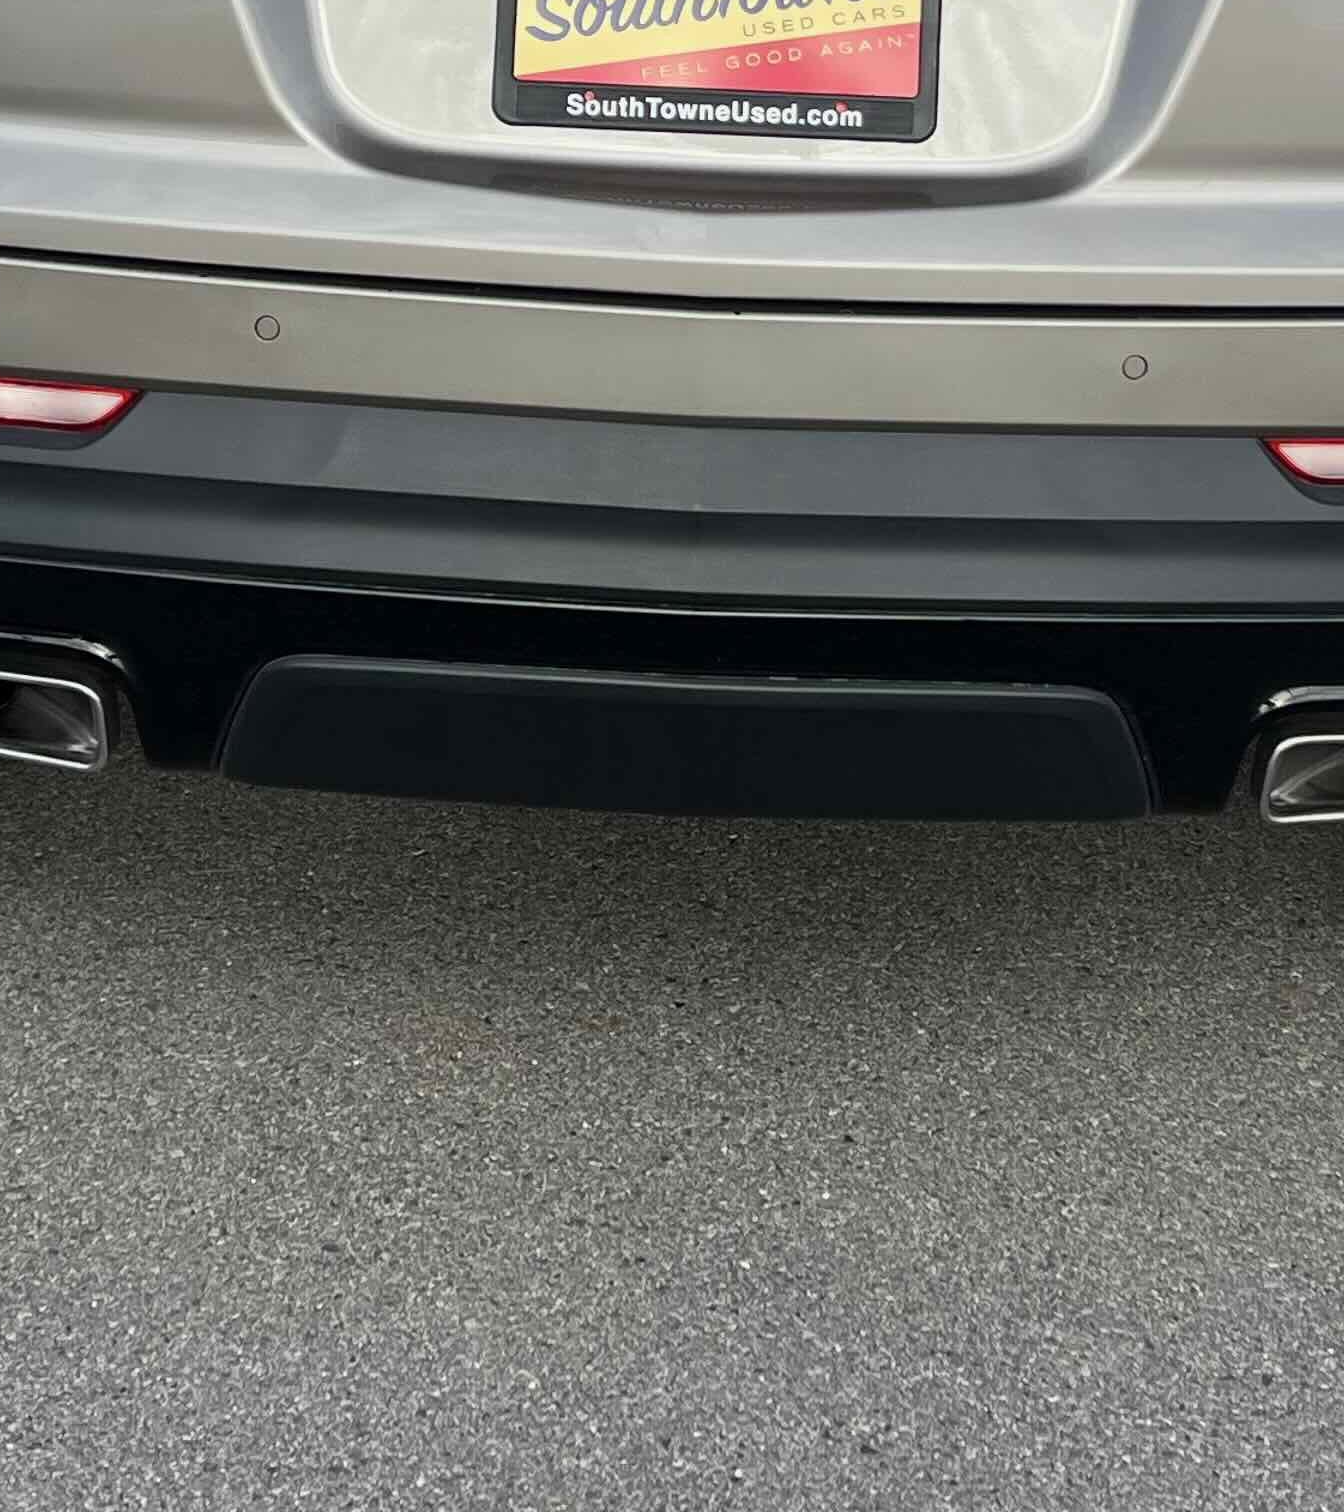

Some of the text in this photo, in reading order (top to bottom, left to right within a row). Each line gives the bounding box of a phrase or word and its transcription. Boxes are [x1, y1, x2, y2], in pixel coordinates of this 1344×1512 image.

[743, 4, 905, 38] USED CARS
[641, 63, 708, 81] FEEL
[725, 48, 802, 71] GOOD
[566, 93, 863, 128] SouthTowneUsed.com
